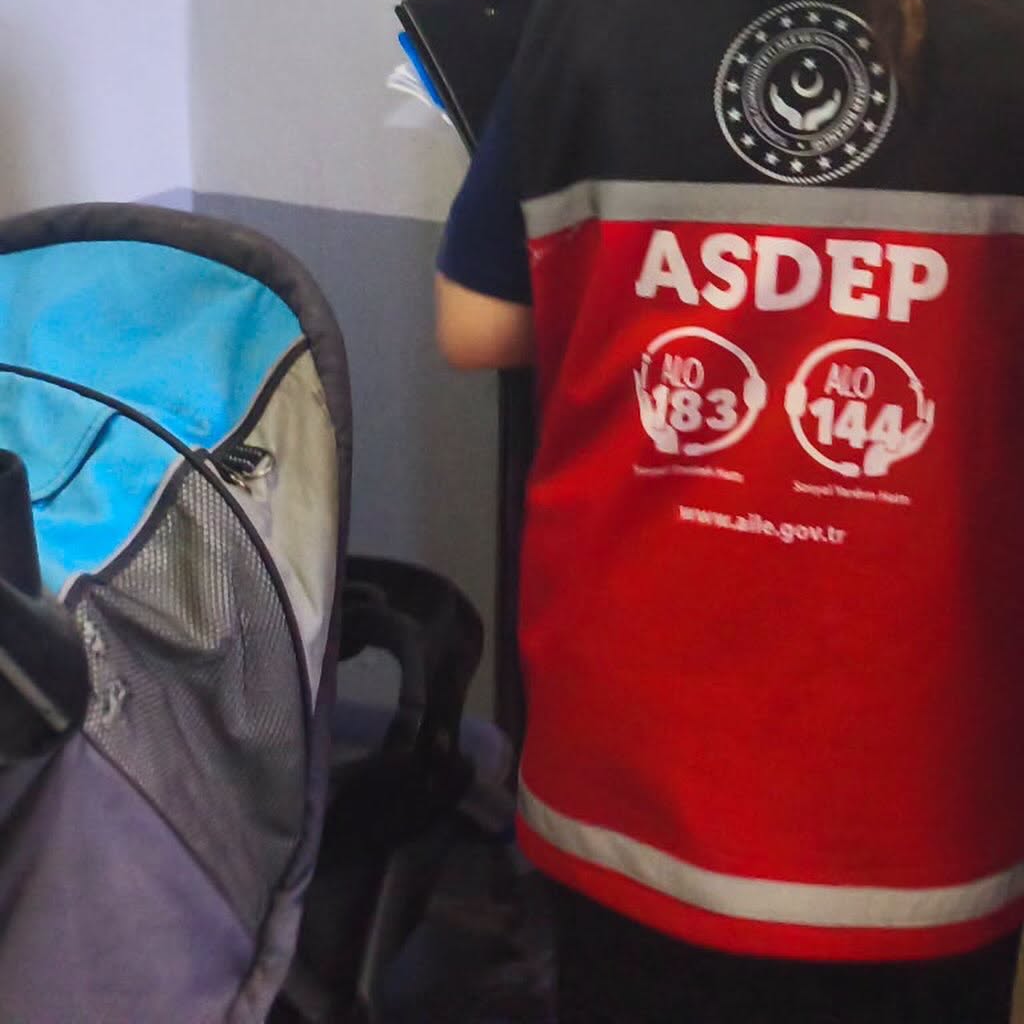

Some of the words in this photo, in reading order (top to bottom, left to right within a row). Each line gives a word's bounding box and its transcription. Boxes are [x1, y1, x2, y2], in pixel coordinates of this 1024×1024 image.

[635, 229, 949, 323] ASDEP
[652, 383, 738, 432] 183
[808, 396, 904, 451] 144
